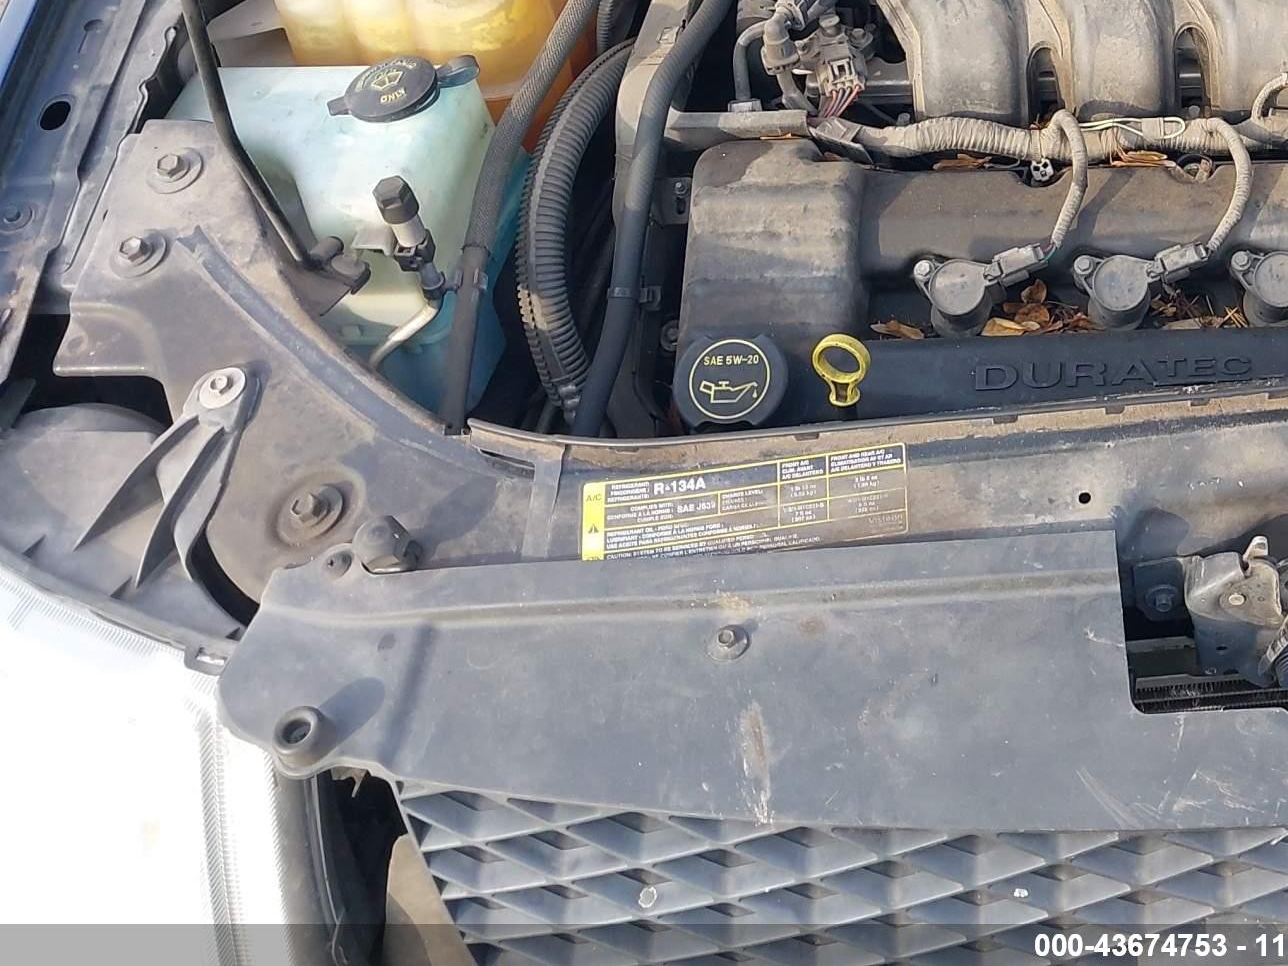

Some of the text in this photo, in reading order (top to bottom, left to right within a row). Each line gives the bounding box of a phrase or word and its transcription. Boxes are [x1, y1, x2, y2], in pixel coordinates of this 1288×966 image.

[703, 354, 759, 365] SAE 5W-20
[975, 356, 1252, 391] DURATEC
[653, 476, 706, 495] R-134A
[677, 504, 694, 513] SAE
